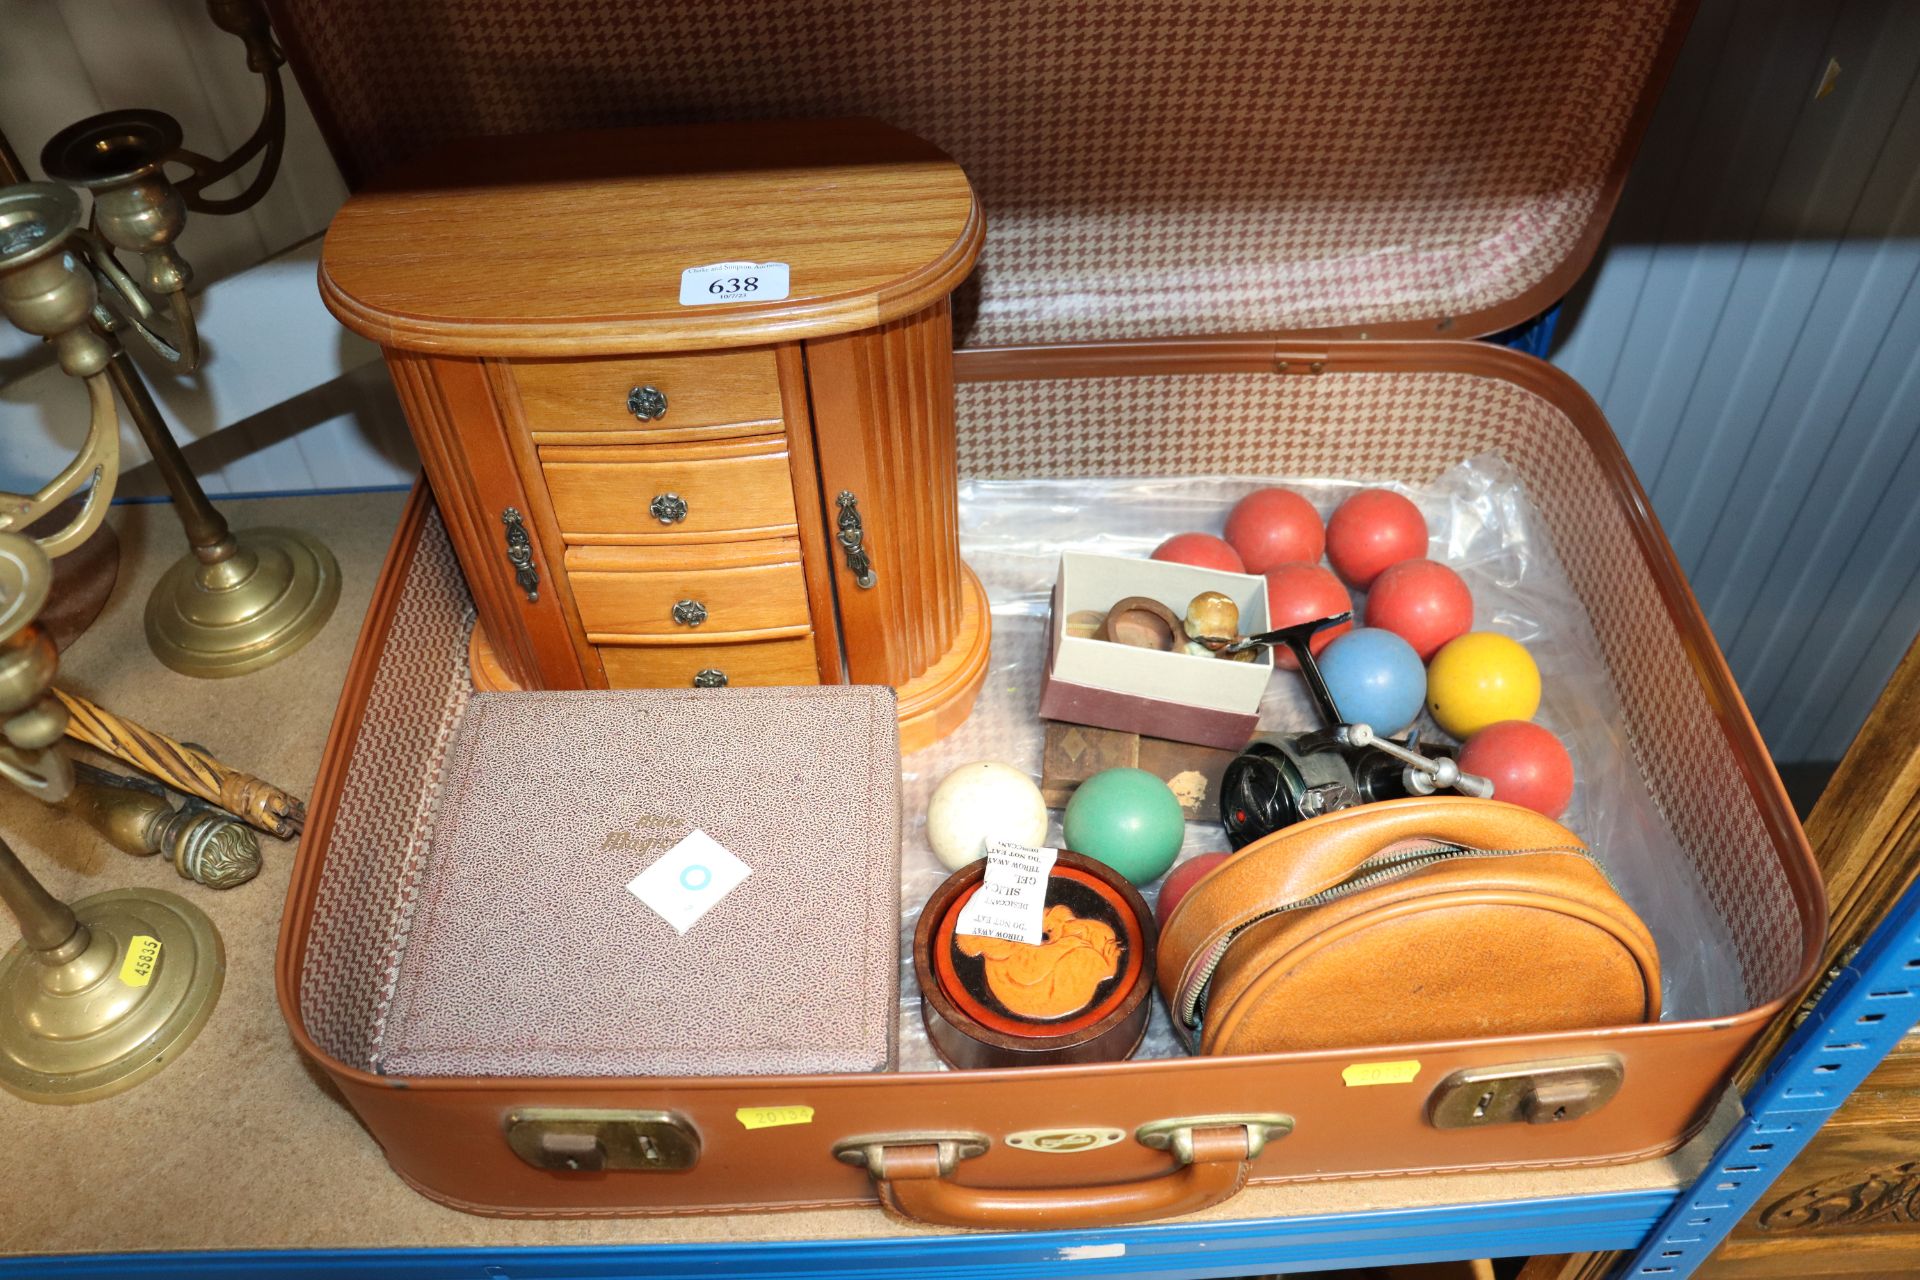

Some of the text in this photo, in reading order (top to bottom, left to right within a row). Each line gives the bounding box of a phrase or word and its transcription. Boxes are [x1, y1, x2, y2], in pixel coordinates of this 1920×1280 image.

[708, 276, 759, 294] 638
[987, 857, 1040, 873] THROW AWAY
[1014, 874, 1037, 886] GEL
[972, 927, 1025, 942] THROW AWAY
[134, 940, 158, 977] 45835
